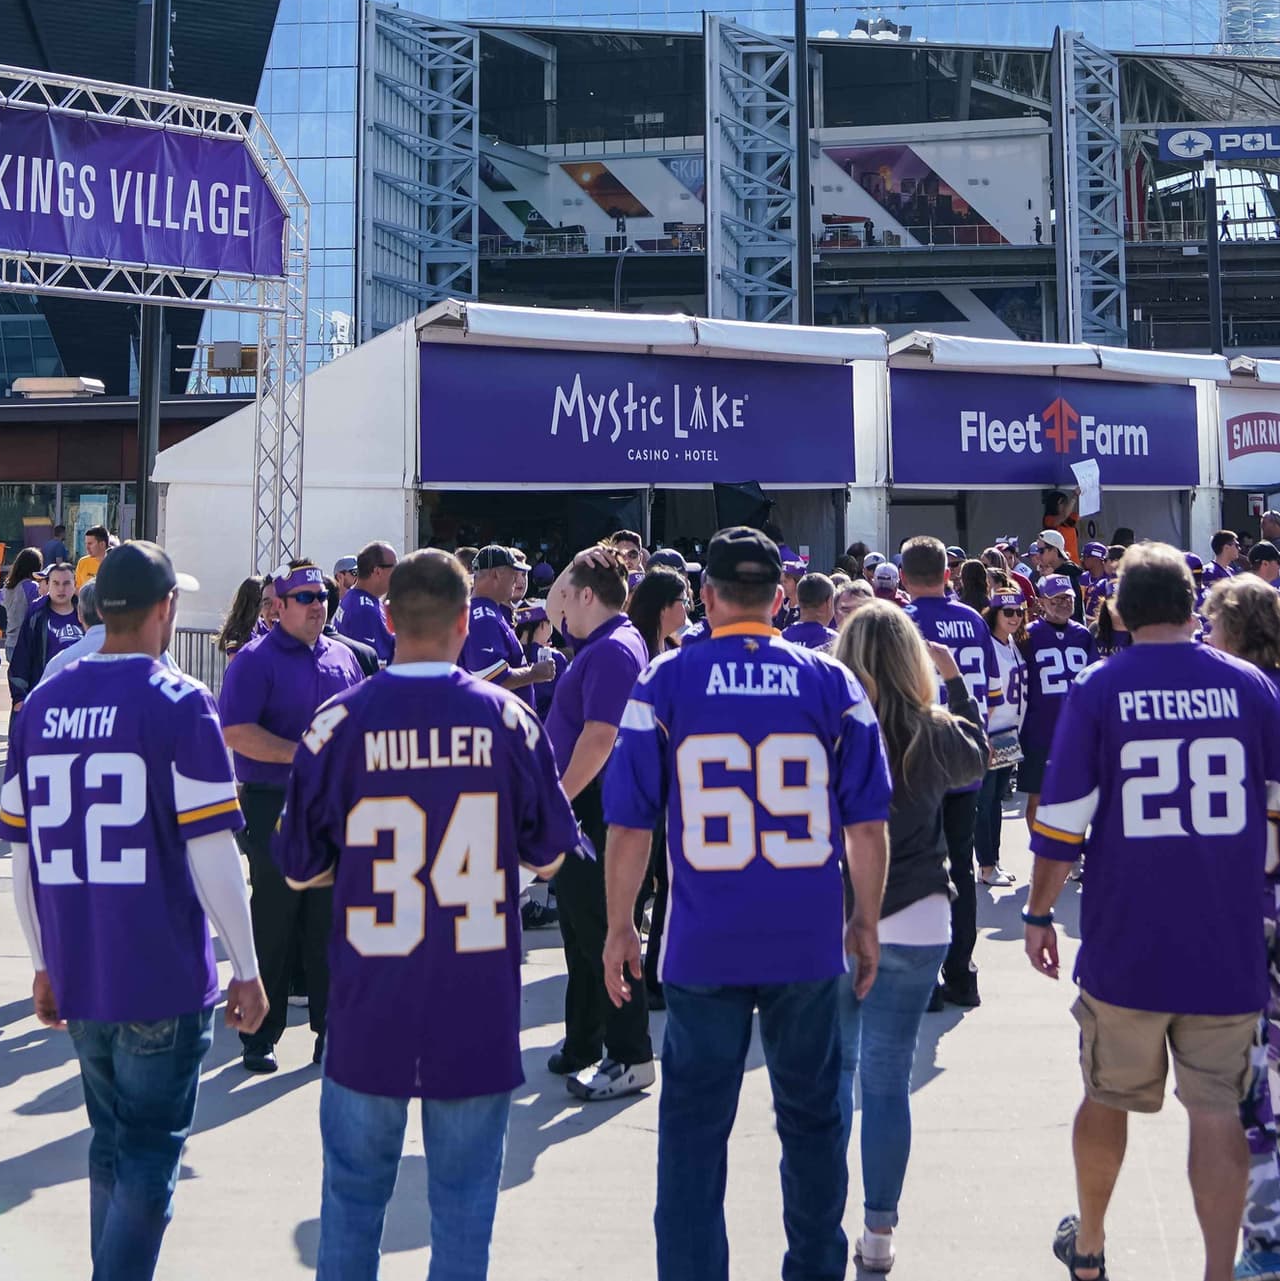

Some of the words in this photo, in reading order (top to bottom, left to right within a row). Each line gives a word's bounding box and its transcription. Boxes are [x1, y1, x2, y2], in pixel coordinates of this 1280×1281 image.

[109, 168, 251, 237] VILLAGE
[627, 448, 670, 461] CASINO
[684, 449, 719, 461] HOTEL
[960, 411, 1043, 454] Fleet
[1080, 415, 1149, 456] Farm
[935, 620, 975, 638] SMITH
[706, 662, 800, 697] ALLEN
[1034, 647, 1088, 695] 29
[41, 705, 118, 739] SMITH
[1118, 687, 1240, 722] PETERSON
[364, 726, 493, 772] MULLER
[676, 732, 834, 871] 69
[1120, 737, 1247, 838] 28
[26, 752, 148, 885] 22
[345, 792, 507, 957] 34
